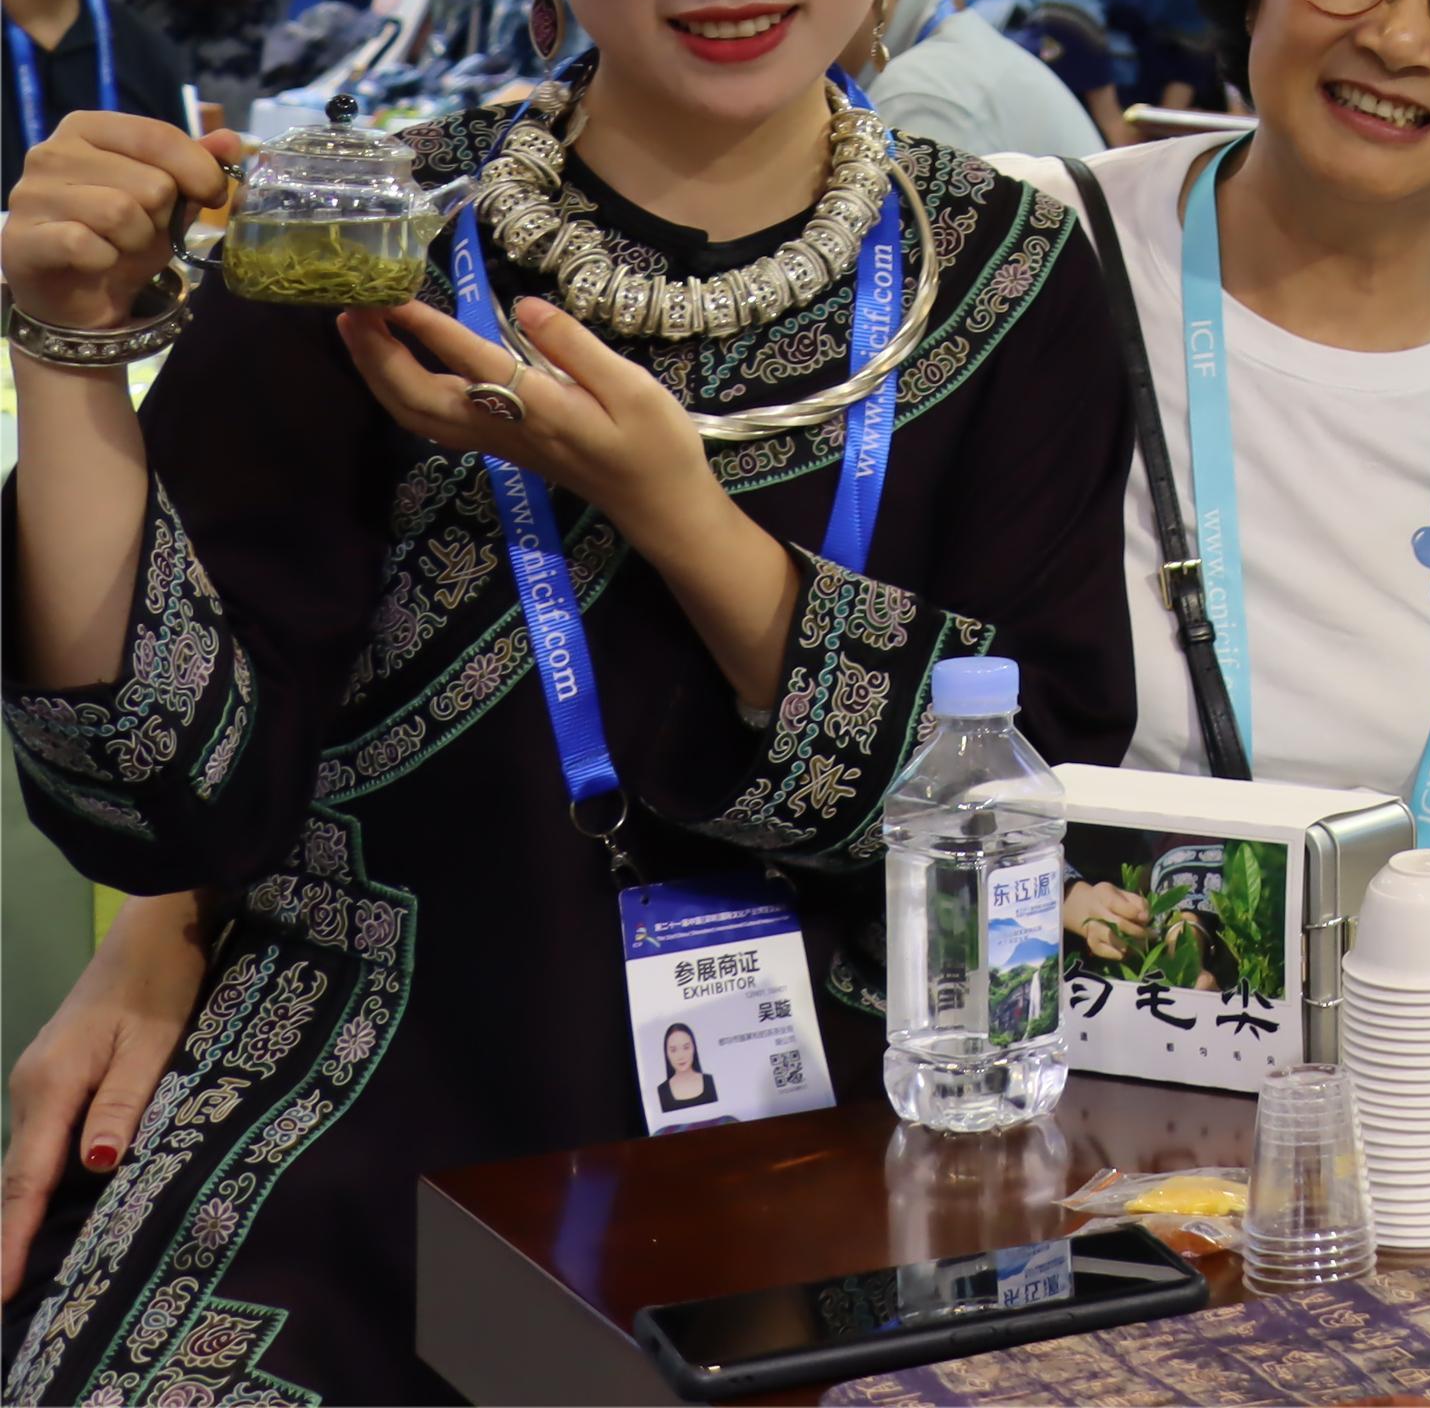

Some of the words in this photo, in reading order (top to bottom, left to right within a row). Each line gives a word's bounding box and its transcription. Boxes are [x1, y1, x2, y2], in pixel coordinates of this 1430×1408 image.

[453, 238, 480, 304] ICIF
[1190, 319, 1216, 378] ICIF
[992, 872, 1052, 907] 东江源
[674, 950, 761, 987] 参展商证
[683, 976, 757, 1000] EXHIBITOR
[1064, 959, 1281, 1042] 匀毛尖
